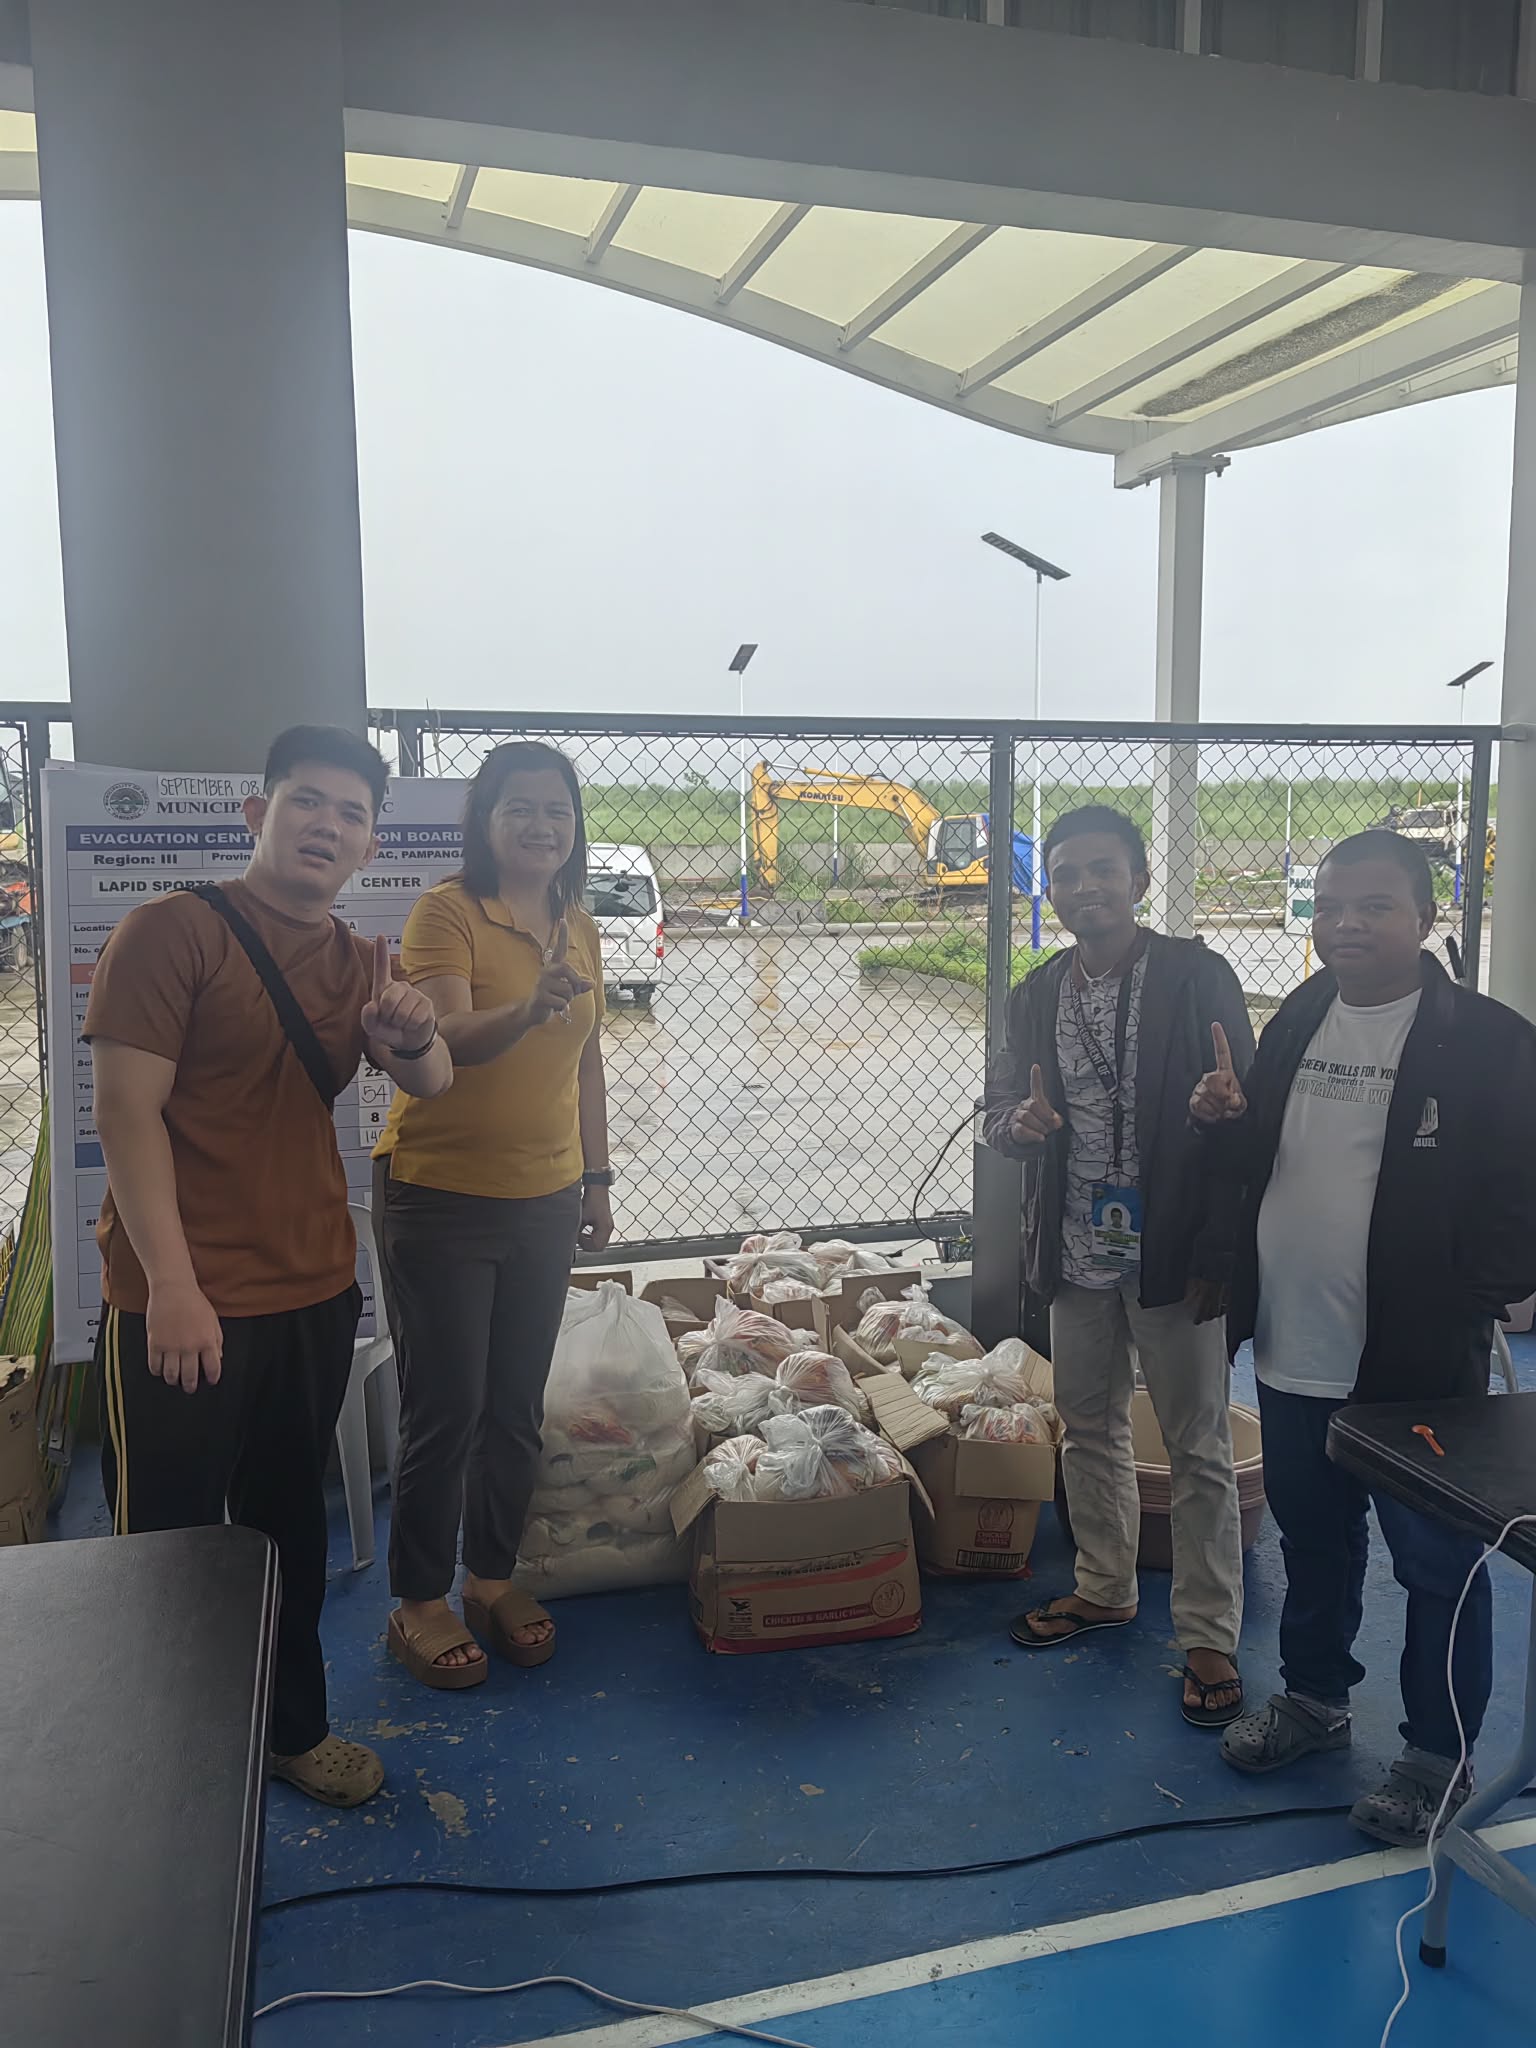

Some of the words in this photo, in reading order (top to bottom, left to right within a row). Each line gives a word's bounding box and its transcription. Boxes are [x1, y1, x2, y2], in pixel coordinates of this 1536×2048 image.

[160, 777, 234, 797] SEPTEMBER
[800, 791, 844, 802] KOMATSU
[157, 801, 244, 814] MUNICIP
[79, 832, 199, 845] EVACUATION
[204, 832, 257, 844] CENT
[407, 831, 464, 842] BOARD
[93, 854, 156, 867] Region:
[161, 853, 178, 865] III
[99, 880, 148, 892] LAPID
[361, 877, 422, 888] CENTER
[364, 1066, 383, 1078] 22
[1299, 1058, 1328, 1073] GREEN
[1328, 1063, 1360, 1078] SKILLS
[1360, 1065, 1377, 1078] FOR
[1327, 1075, 1358, 1087] towards
[361, 1084, 389, 1105] 54
[371, 1112, 380, 1123] 8
